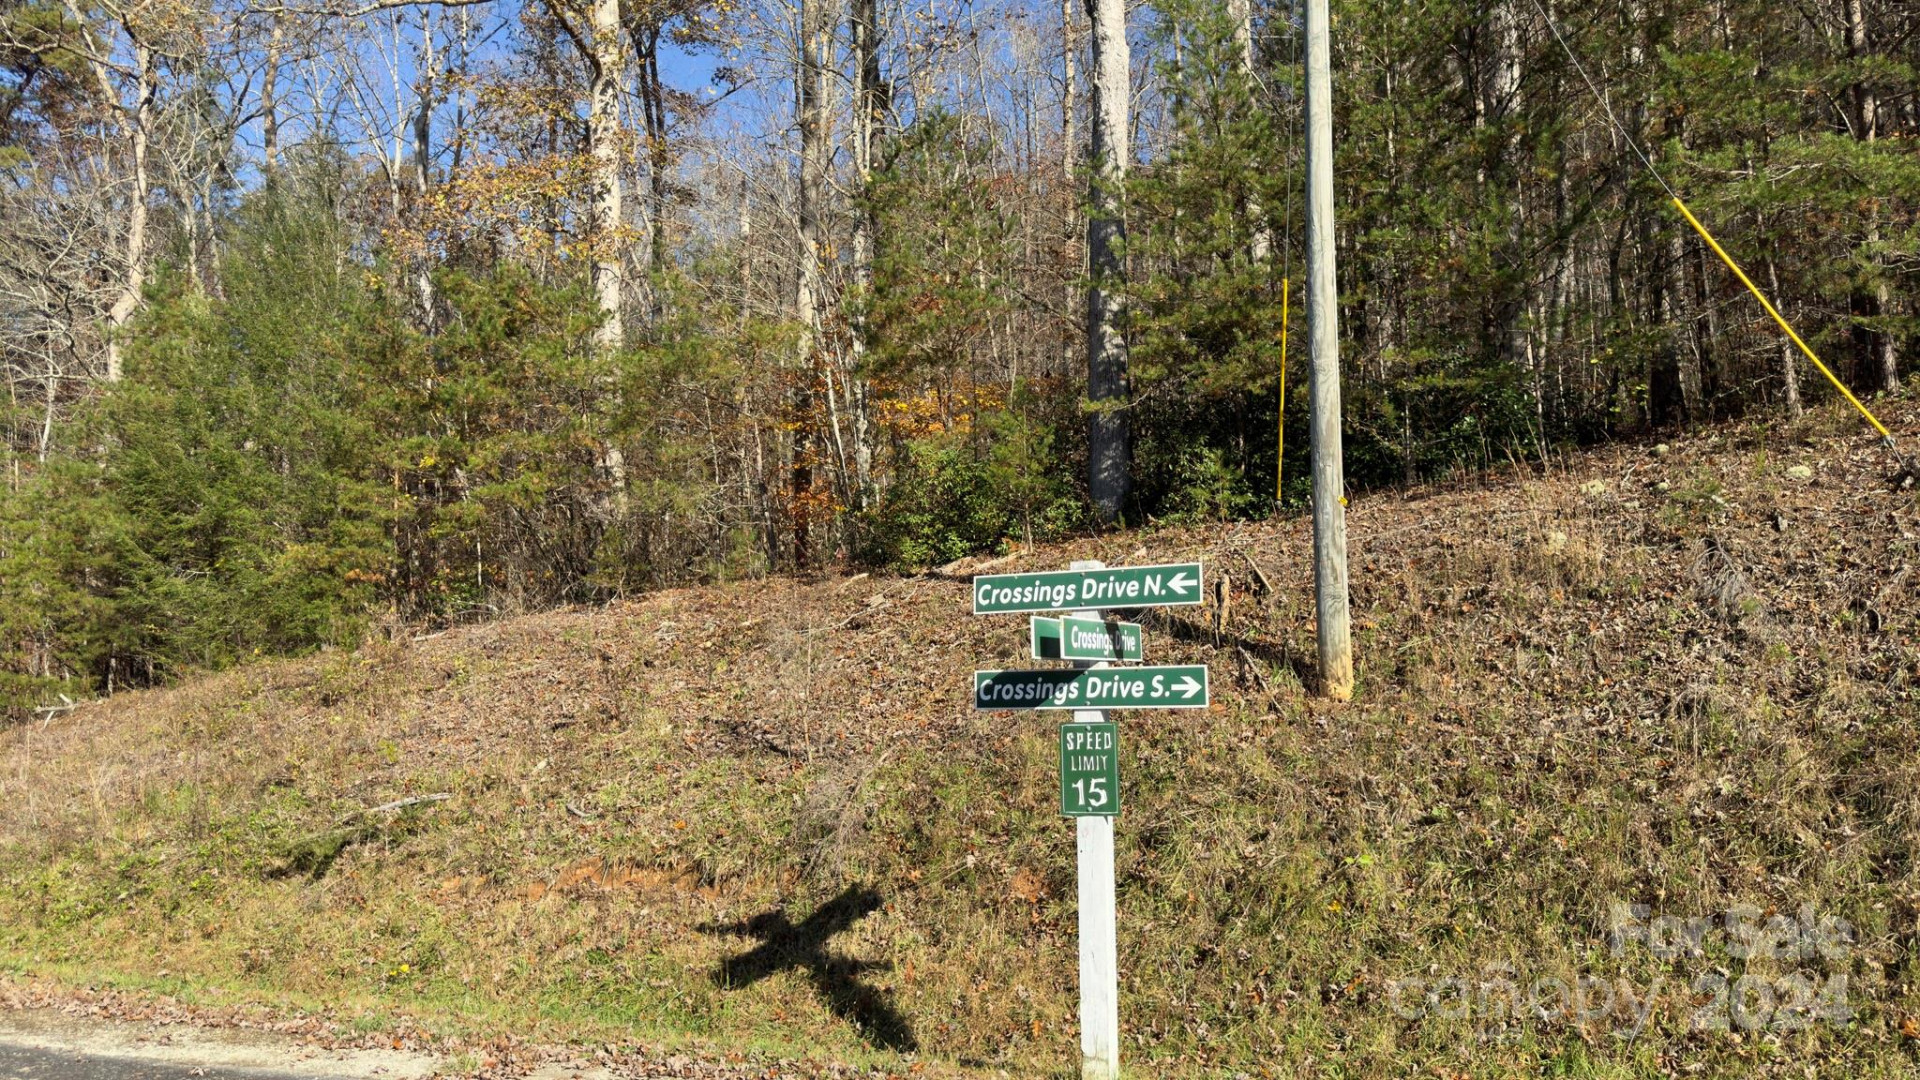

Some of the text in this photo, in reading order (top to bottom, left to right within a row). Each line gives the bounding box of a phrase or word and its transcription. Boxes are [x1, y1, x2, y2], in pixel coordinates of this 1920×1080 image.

[978, 574, 1166, 607] Crossings Drive N.
[1071, 625, 1136, 655] Crossings Drive
[979, 675, 1170, 704] Crossings Drive S.
[1066, 732, 1112, 750] SPEED
[1071, 755, 1108, 771] LIMIT
[1072, 777, 1108, 807] 15
